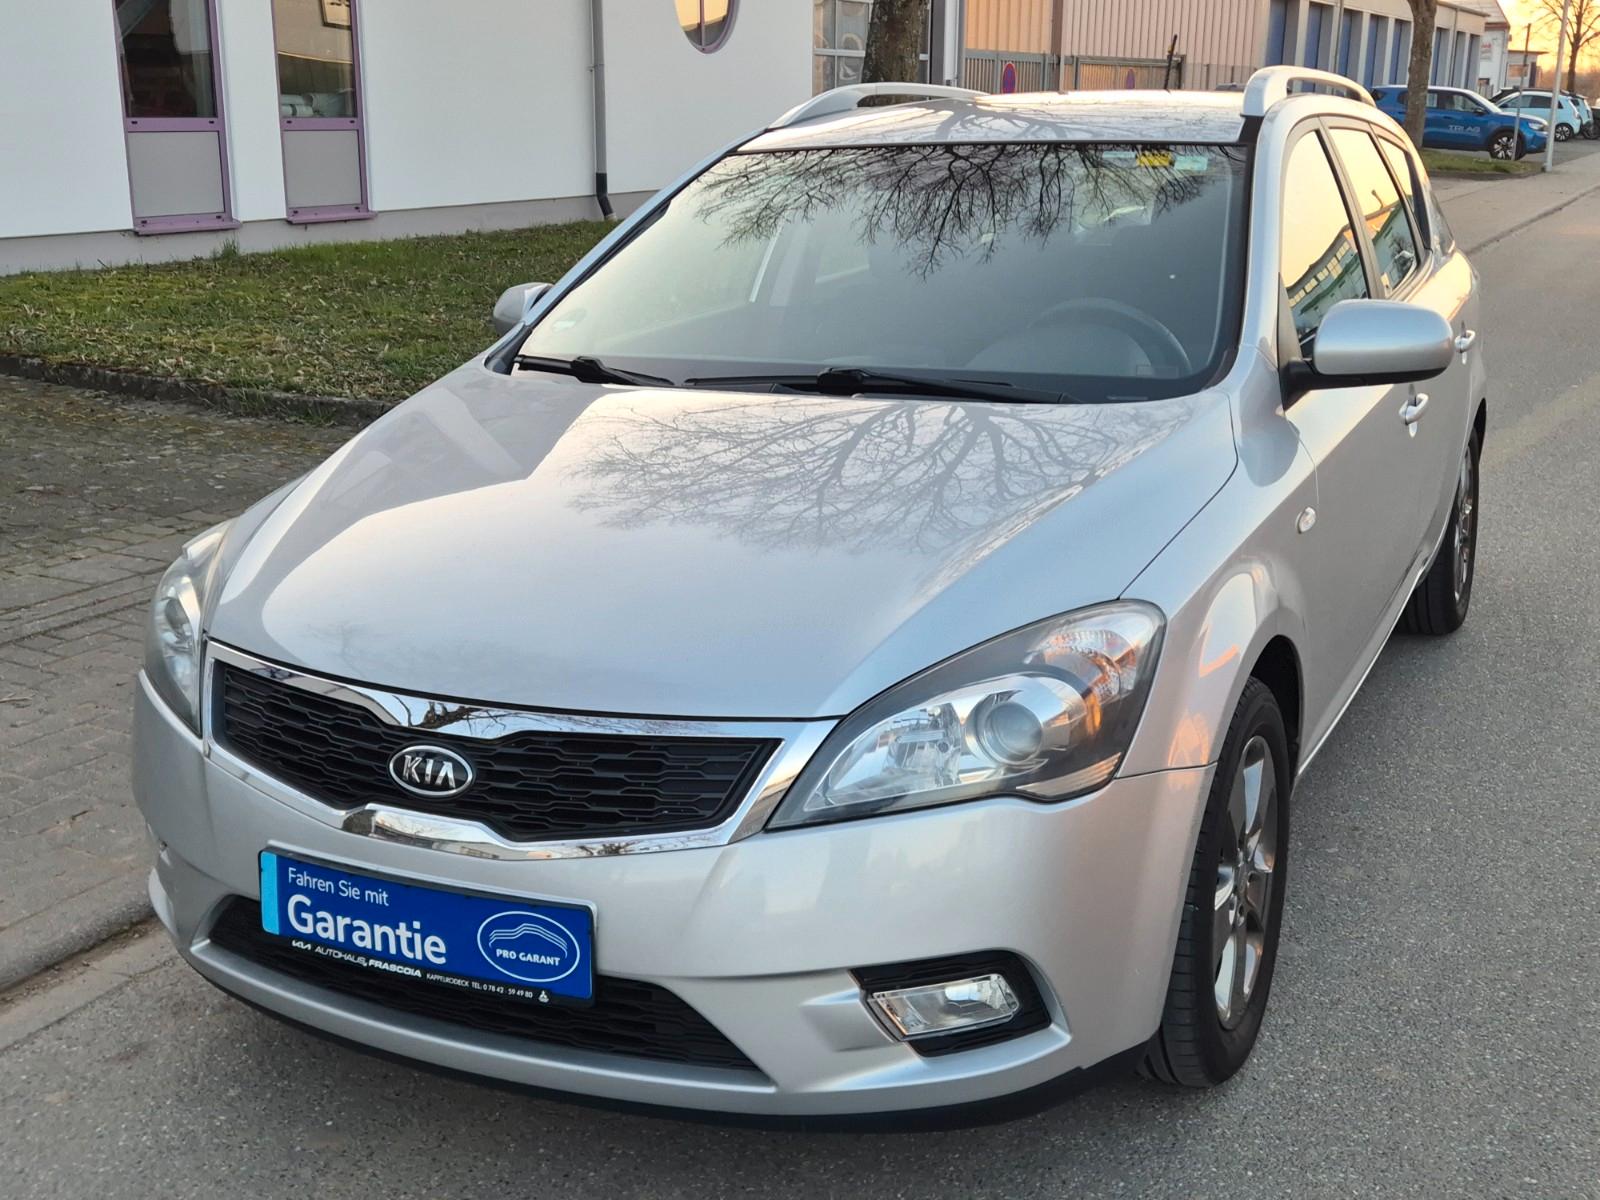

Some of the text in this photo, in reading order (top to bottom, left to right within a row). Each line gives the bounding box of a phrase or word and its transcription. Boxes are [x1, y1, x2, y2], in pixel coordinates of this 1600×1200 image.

[403, 755, 455, 788] KIA
[288, 867, 390, 907] Fahren Sie mit
[288, 894, 446, 964] Garantie
[496, 948, 561, 967] PRO GARANT
